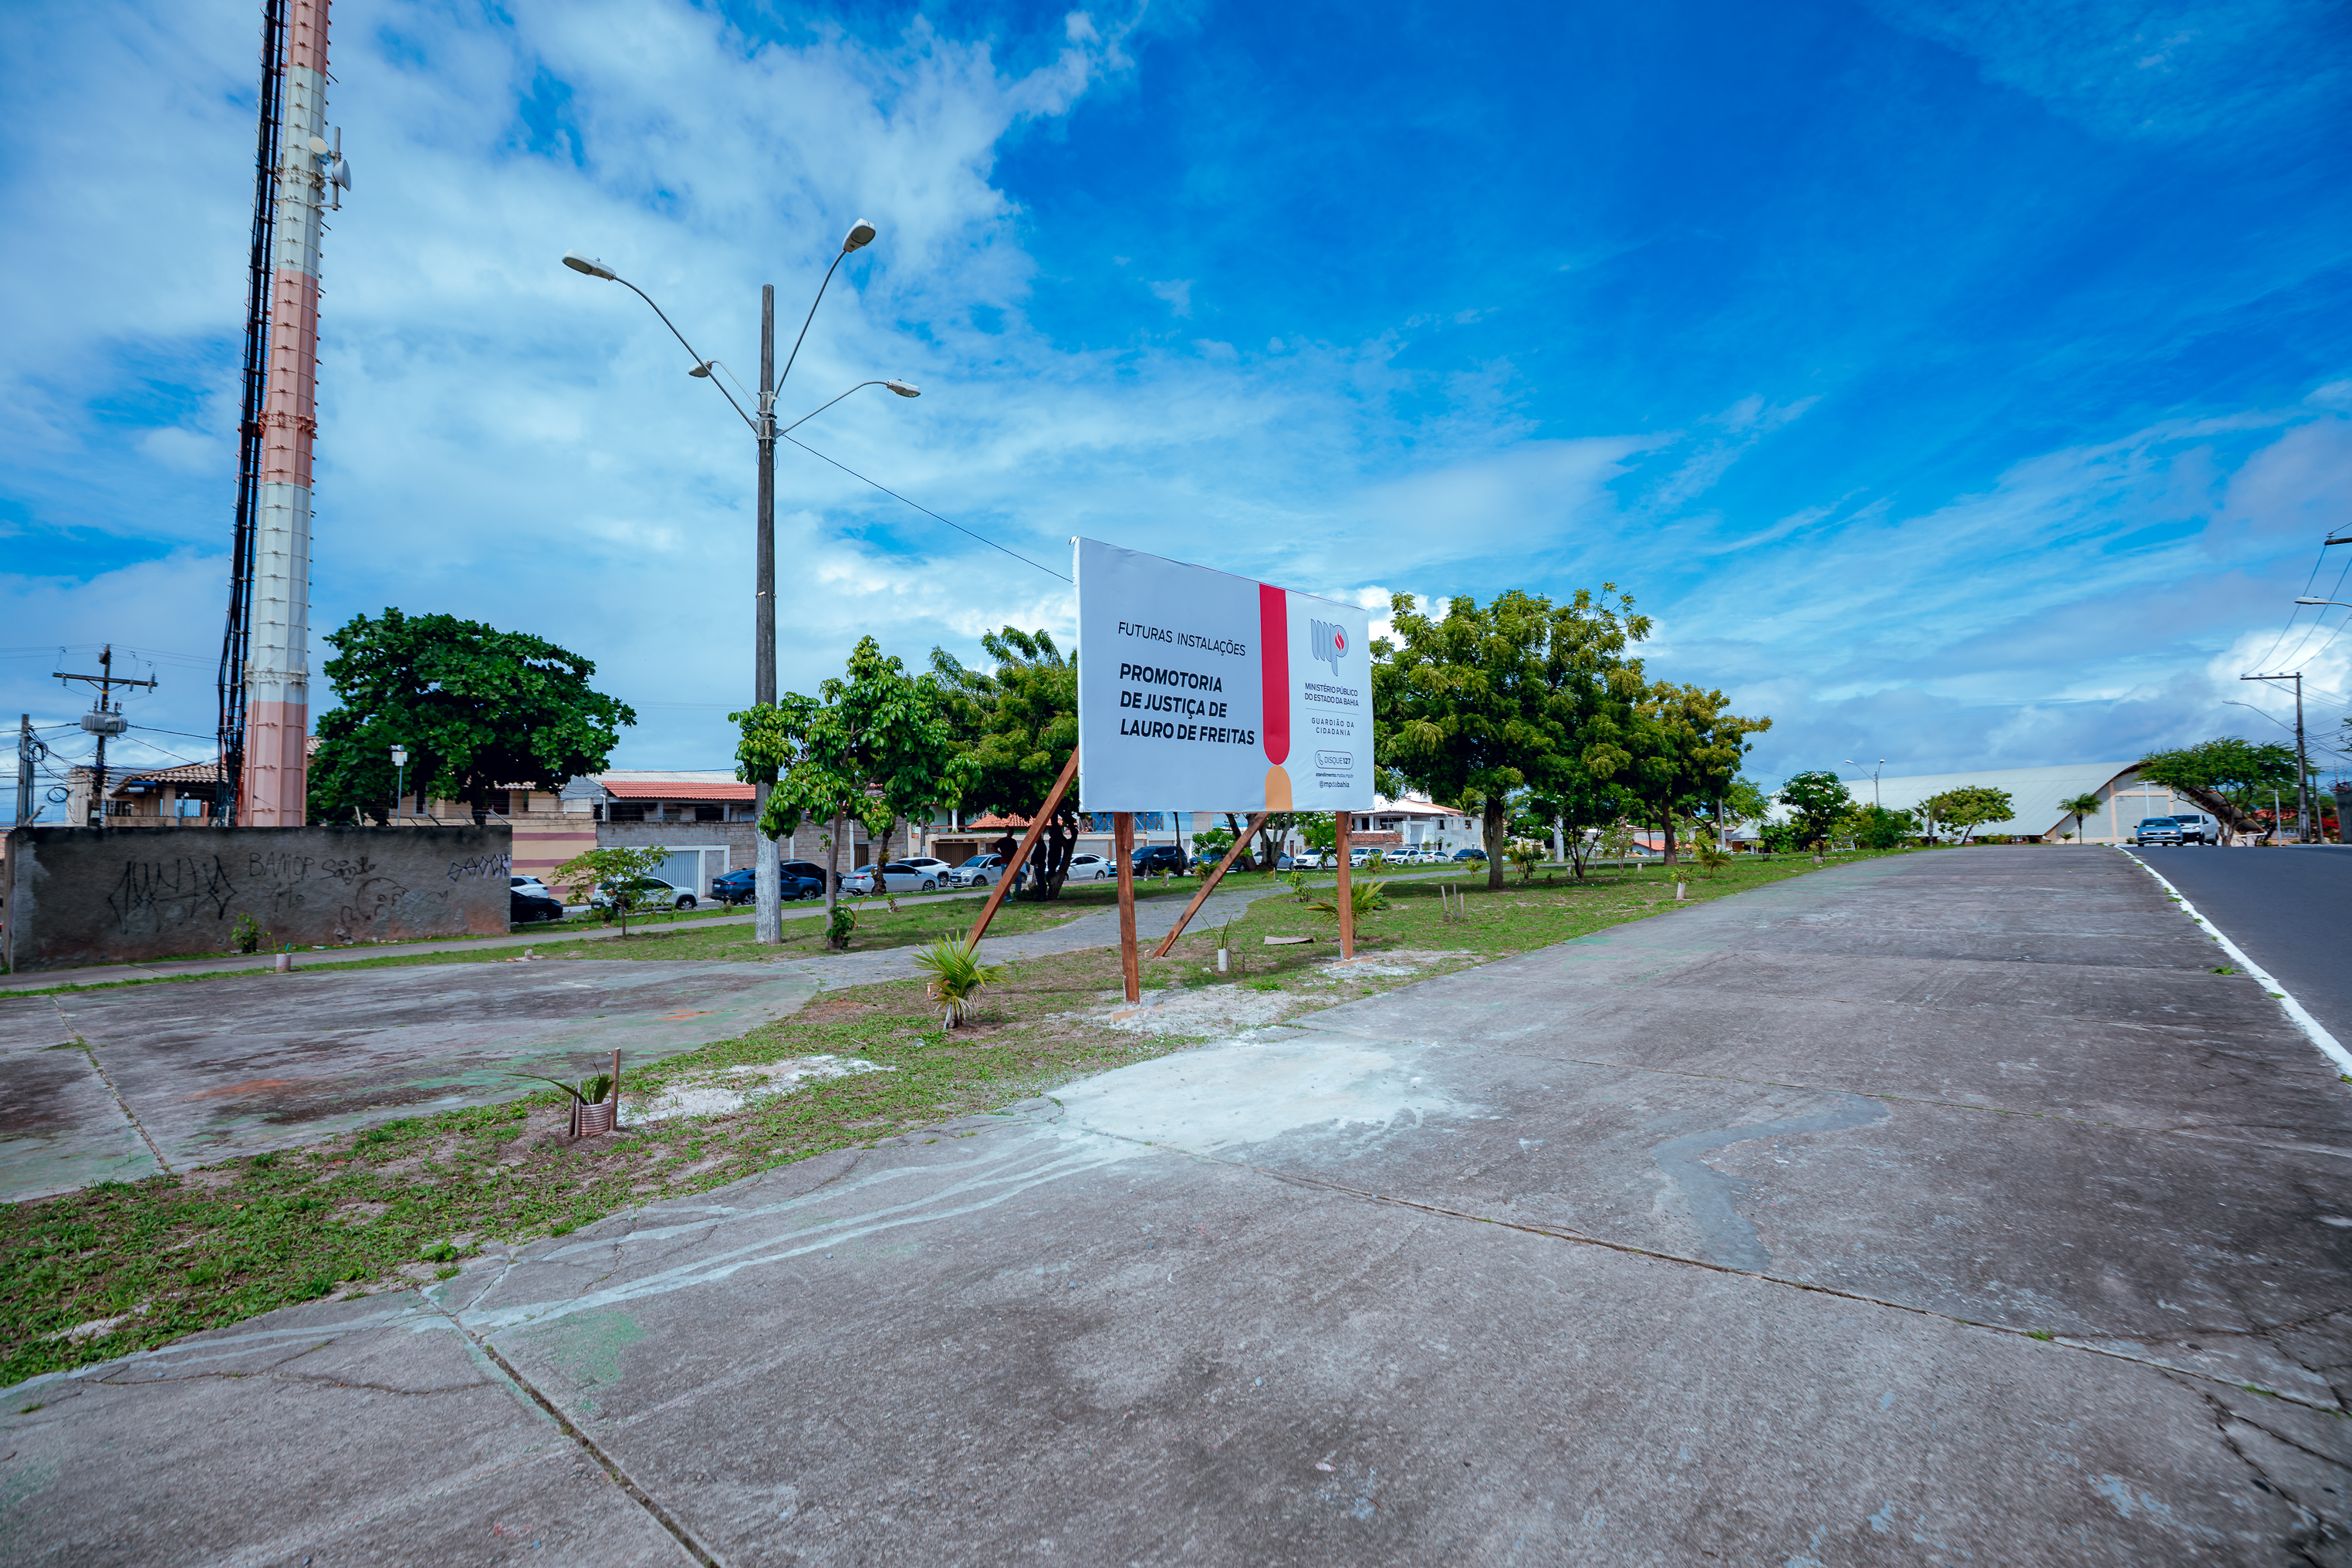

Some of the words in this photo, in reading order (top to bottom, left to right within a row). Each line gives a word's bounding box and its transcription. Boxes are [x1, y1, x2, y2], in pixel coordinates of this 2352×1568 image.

[1118, 621, 1173, 643] FUTURAS
[1177, 632, 1246, 656] INSTALAÇÕES
[1120, 663, 1222, 693] PROMOTORIA
[1305, 683, 1336, 694] MINISTÉRIO
[1336, 686, 1358, 697] PÚBLICO
[1120, 691, 1143, 708] DE
[1144, 694, 1205, 719] JUSTIÇA
[1208, 701, 1228, 718] DE
[1313, 694, 1335, 704] ESTADO
[1343, 698, 1359, 707] BAHIA
[1311, 717, 1344, 727] GUARDIÃO
[1120, 718, 1174, 738] LAURO
[1177, 724, 1197, 741] DE
[1199, 725, 1255, 745] FREITAS
[1316, 727, 1350, 736] CIDADANIA
[1324, 756, 1343, 765] DISQUE
[1319, 780, 1350, 789] @mpdabahia
